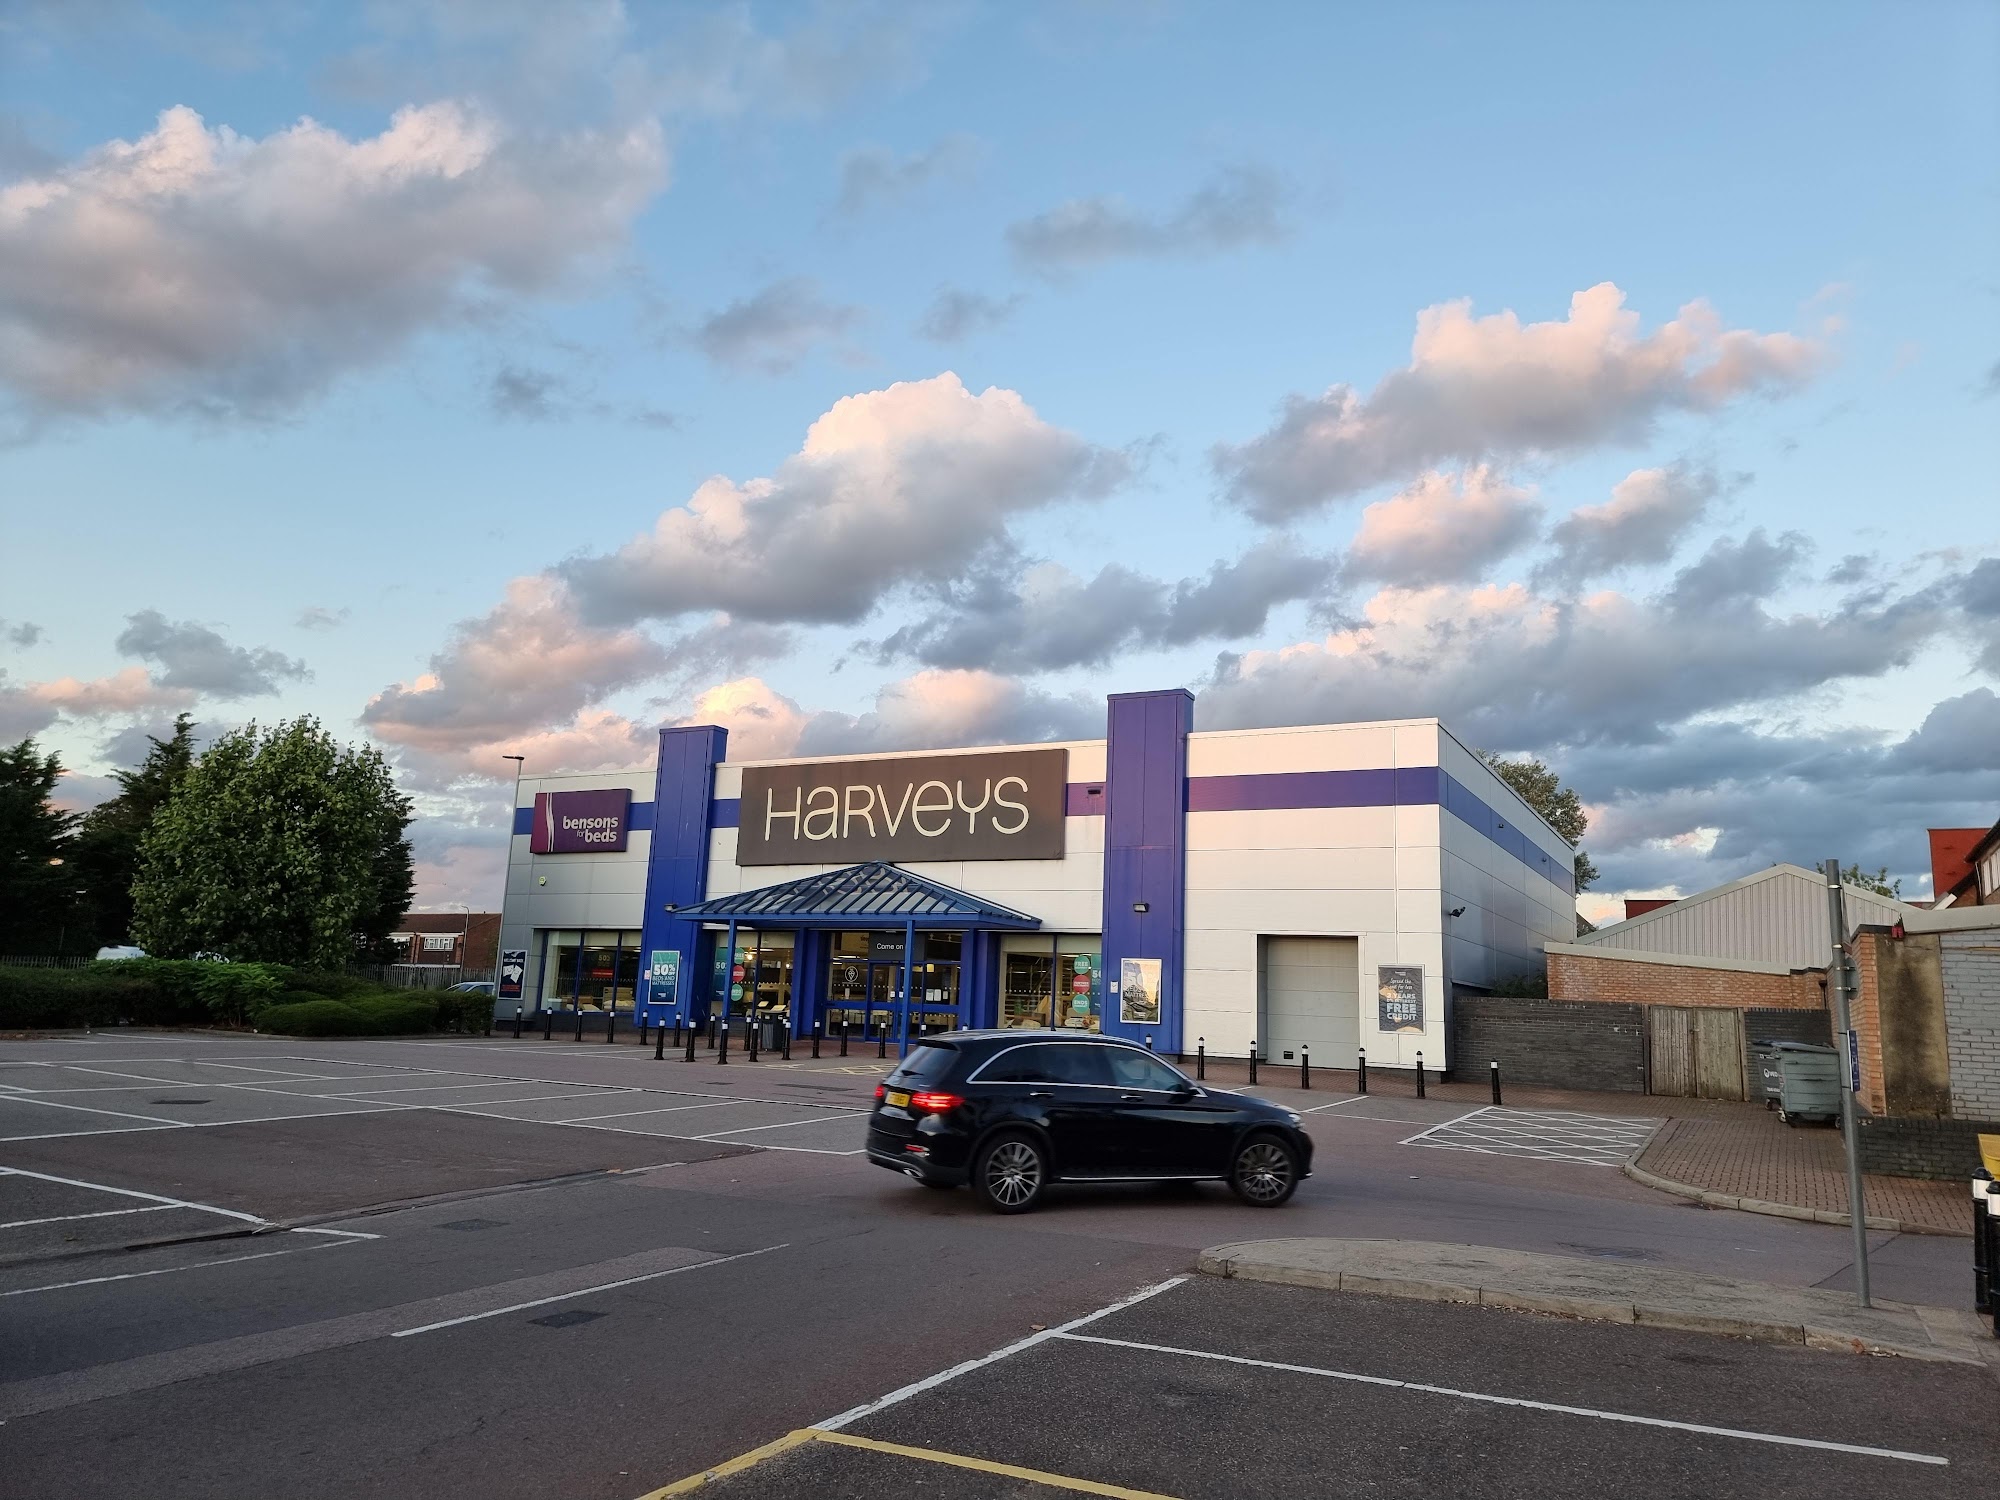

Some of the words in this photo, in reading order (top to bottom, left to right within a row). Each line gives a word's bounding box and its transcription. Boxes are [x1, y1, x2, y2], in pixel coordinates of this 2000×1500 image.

[562, 815, 619, 830] bensons
[576, 830, 585, 838] for
[584, 828, 618, 843] beds
[1386, 1002, 1417, 1014] FREE
[1386, 1012, 1417, 1021] CREDIT
